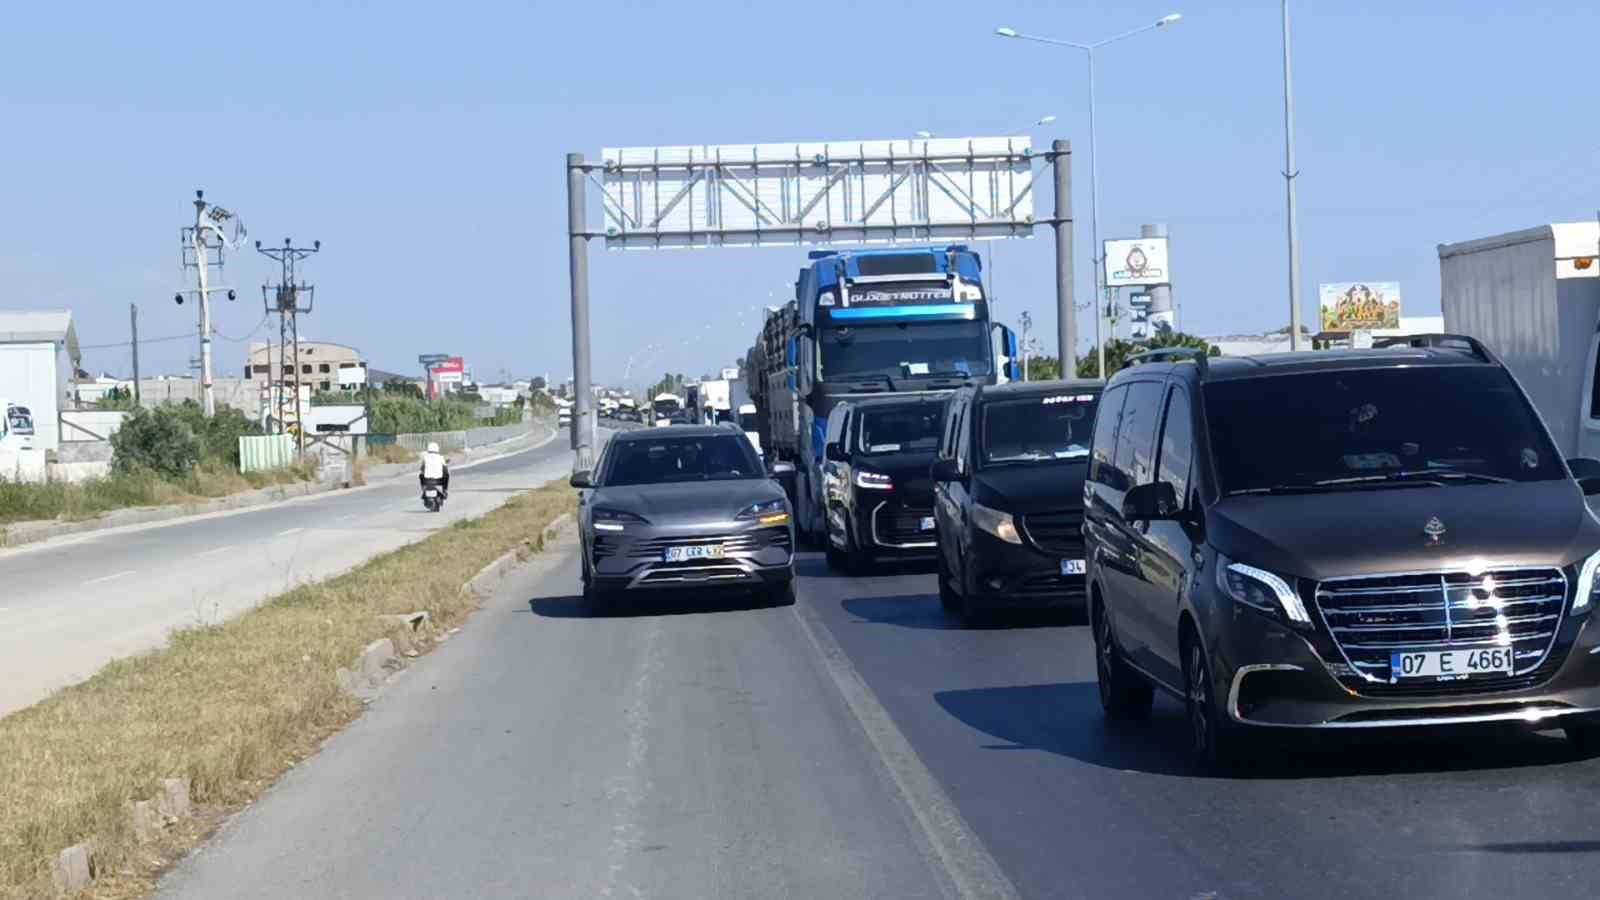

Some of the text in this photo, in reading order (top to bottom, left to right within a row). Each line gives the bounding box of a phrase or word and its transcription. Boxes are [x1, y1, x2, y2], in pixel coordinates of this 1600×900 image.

[1402, 648, 1512, 674] 07 E 4661
